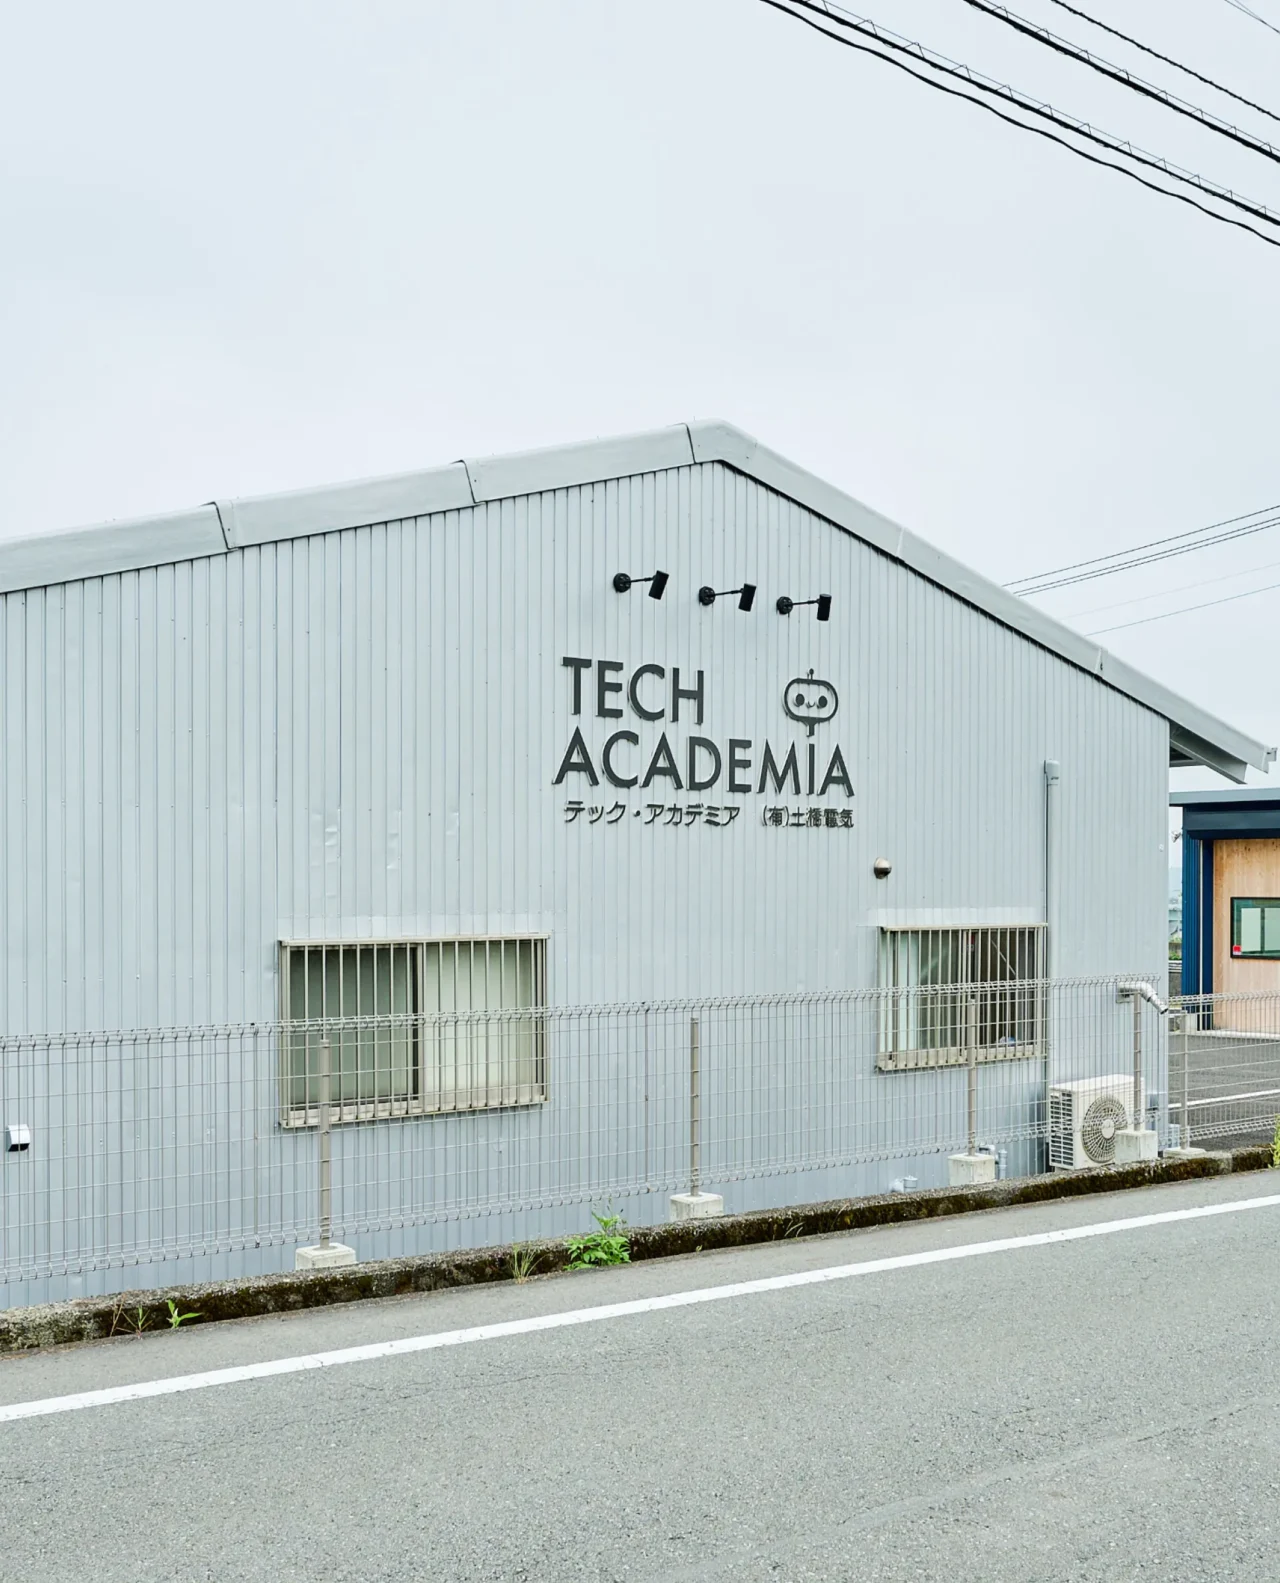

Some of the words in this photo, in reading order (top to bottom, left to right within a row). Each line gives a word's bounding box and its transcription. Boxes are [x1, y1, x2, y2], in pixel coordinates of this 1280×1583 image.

[562, 656, 704, 725] TECH
[552, 725, 855, 798] ACADEMIA
[564, 800, 741, 827] テック・アカデミア
